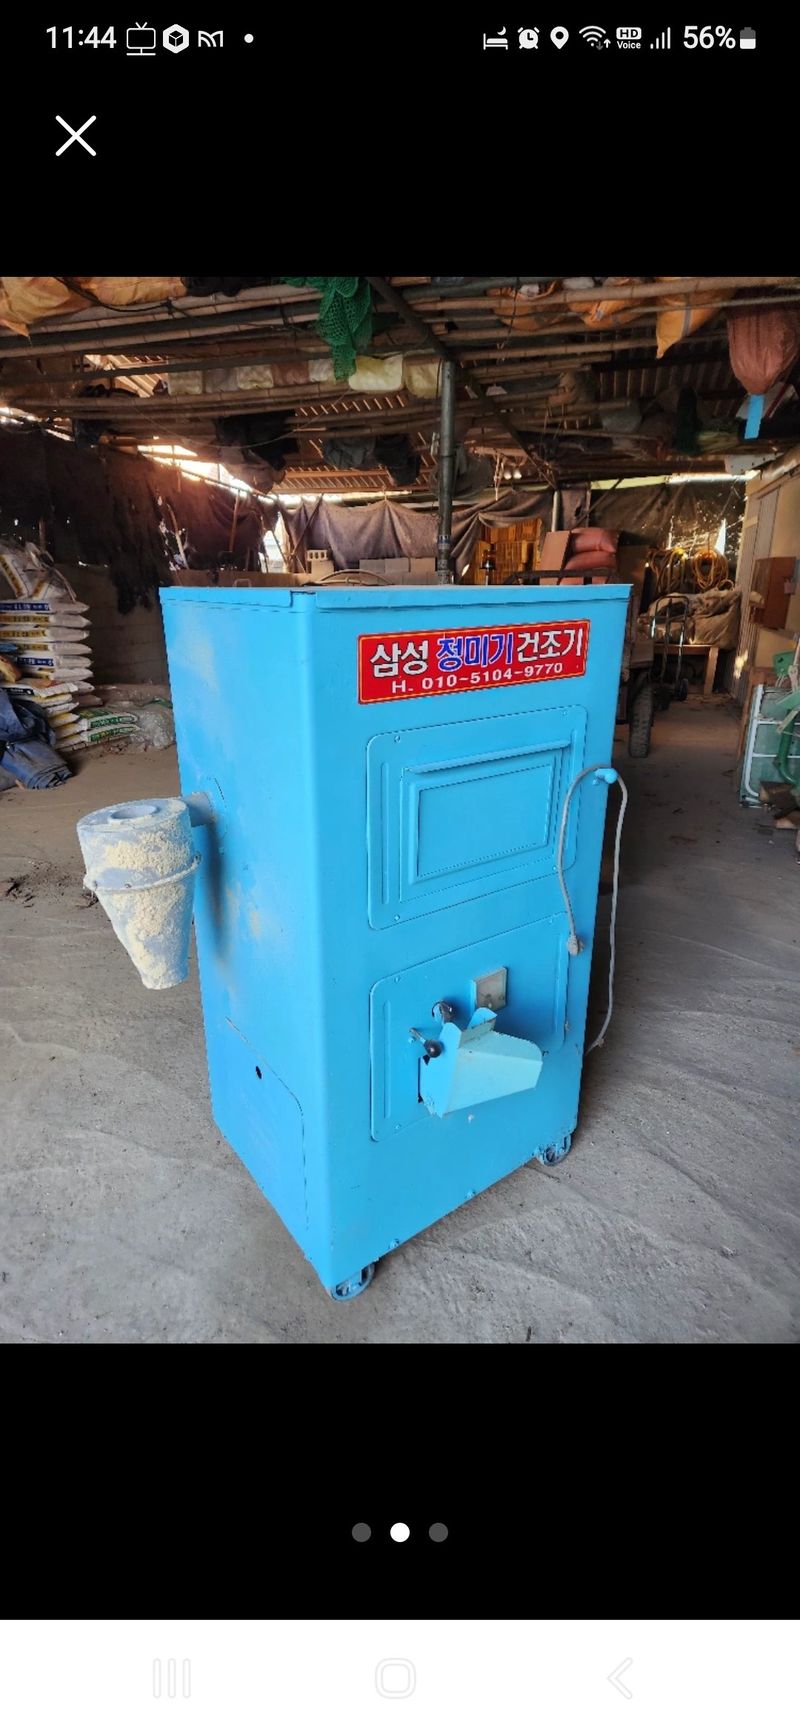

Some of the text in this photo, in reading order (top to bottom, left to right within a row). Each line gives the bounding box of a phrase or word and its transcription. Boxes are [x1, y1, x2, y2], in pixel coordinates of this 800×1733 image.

[370, 629, 583, 678] 삼성 정미기 건조기
[391, 662, 563, 694] H. 010-5104-9770
